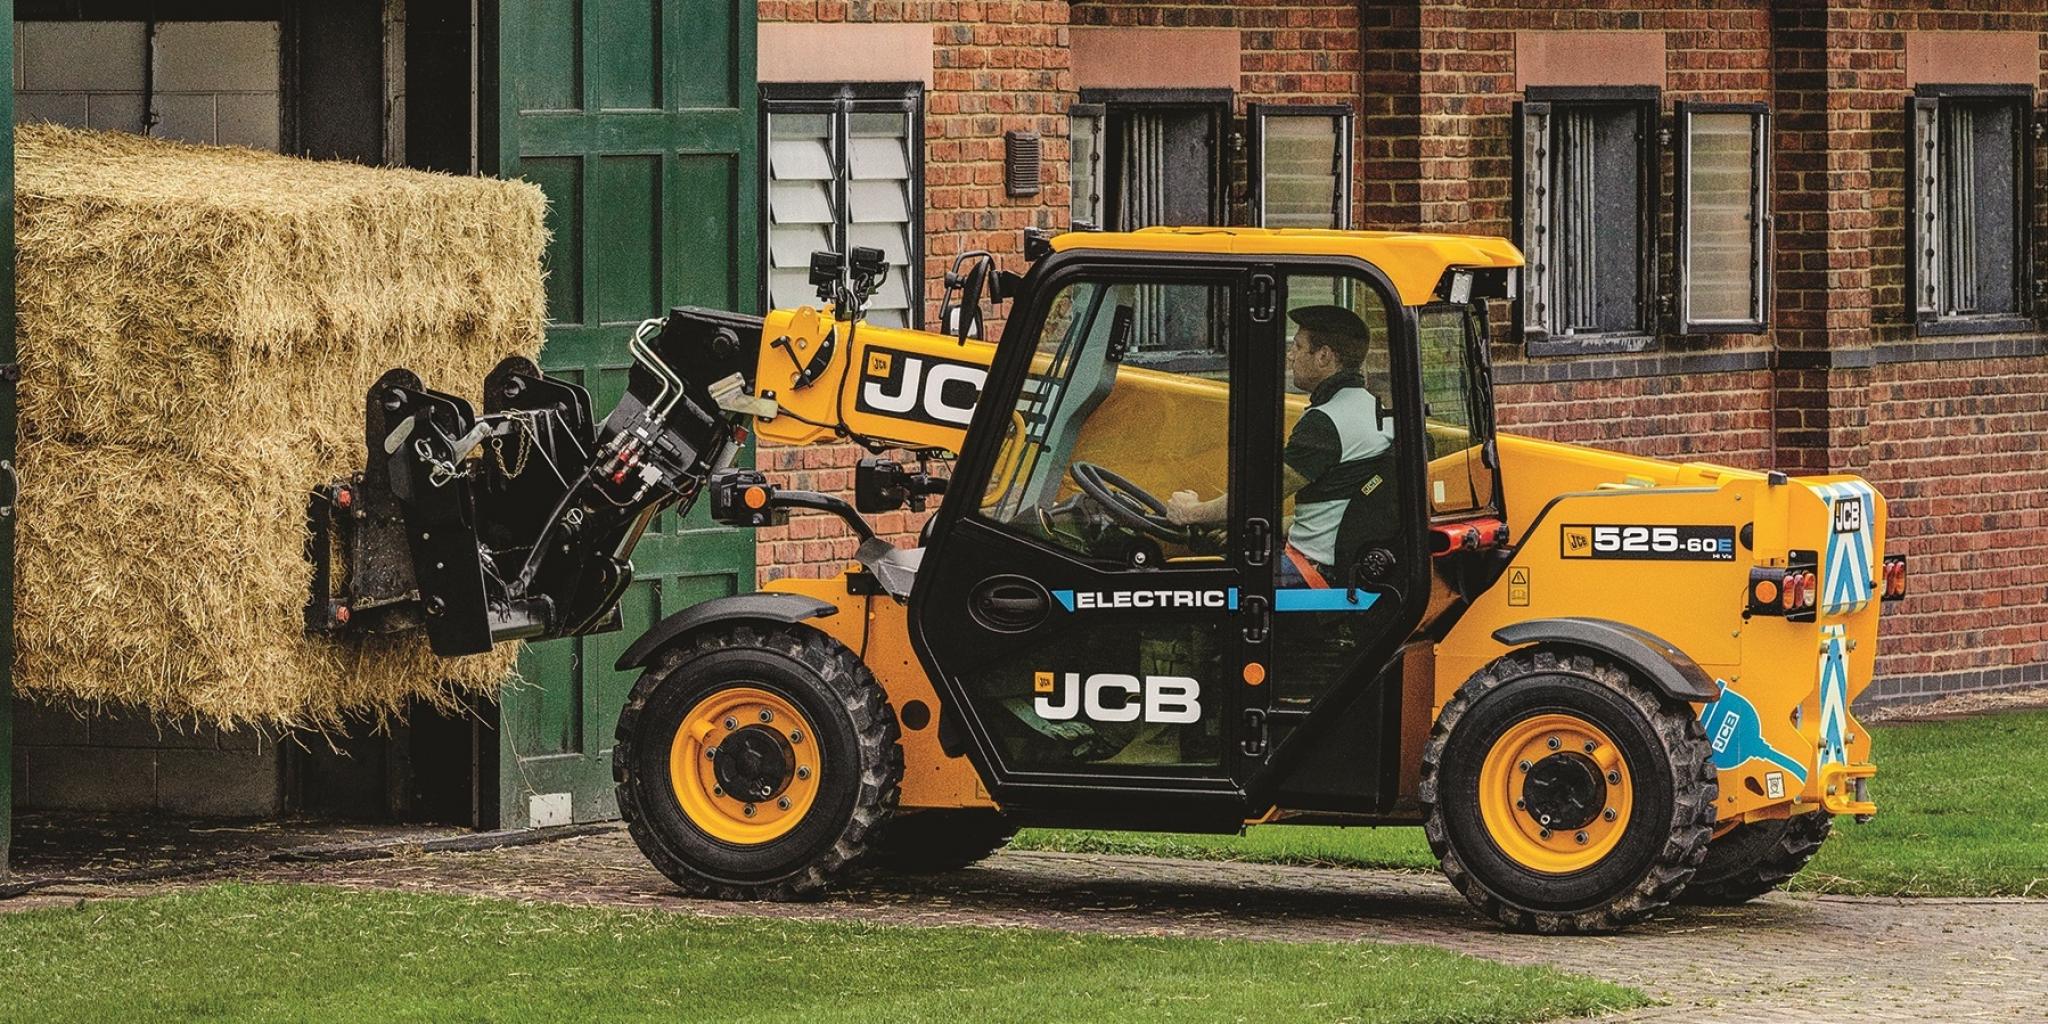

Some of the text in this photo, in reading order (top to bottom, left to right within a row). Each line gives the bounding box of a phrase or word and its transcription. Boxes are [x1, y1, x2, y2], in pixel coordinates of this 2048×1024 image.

[1835, 501, 1860, 531] JCB
[1076, 590, 1225, 609] ELECTRIC
[1034, 672, 1201, 724] JCB
[1713, 713, 1738, 750] JCB
